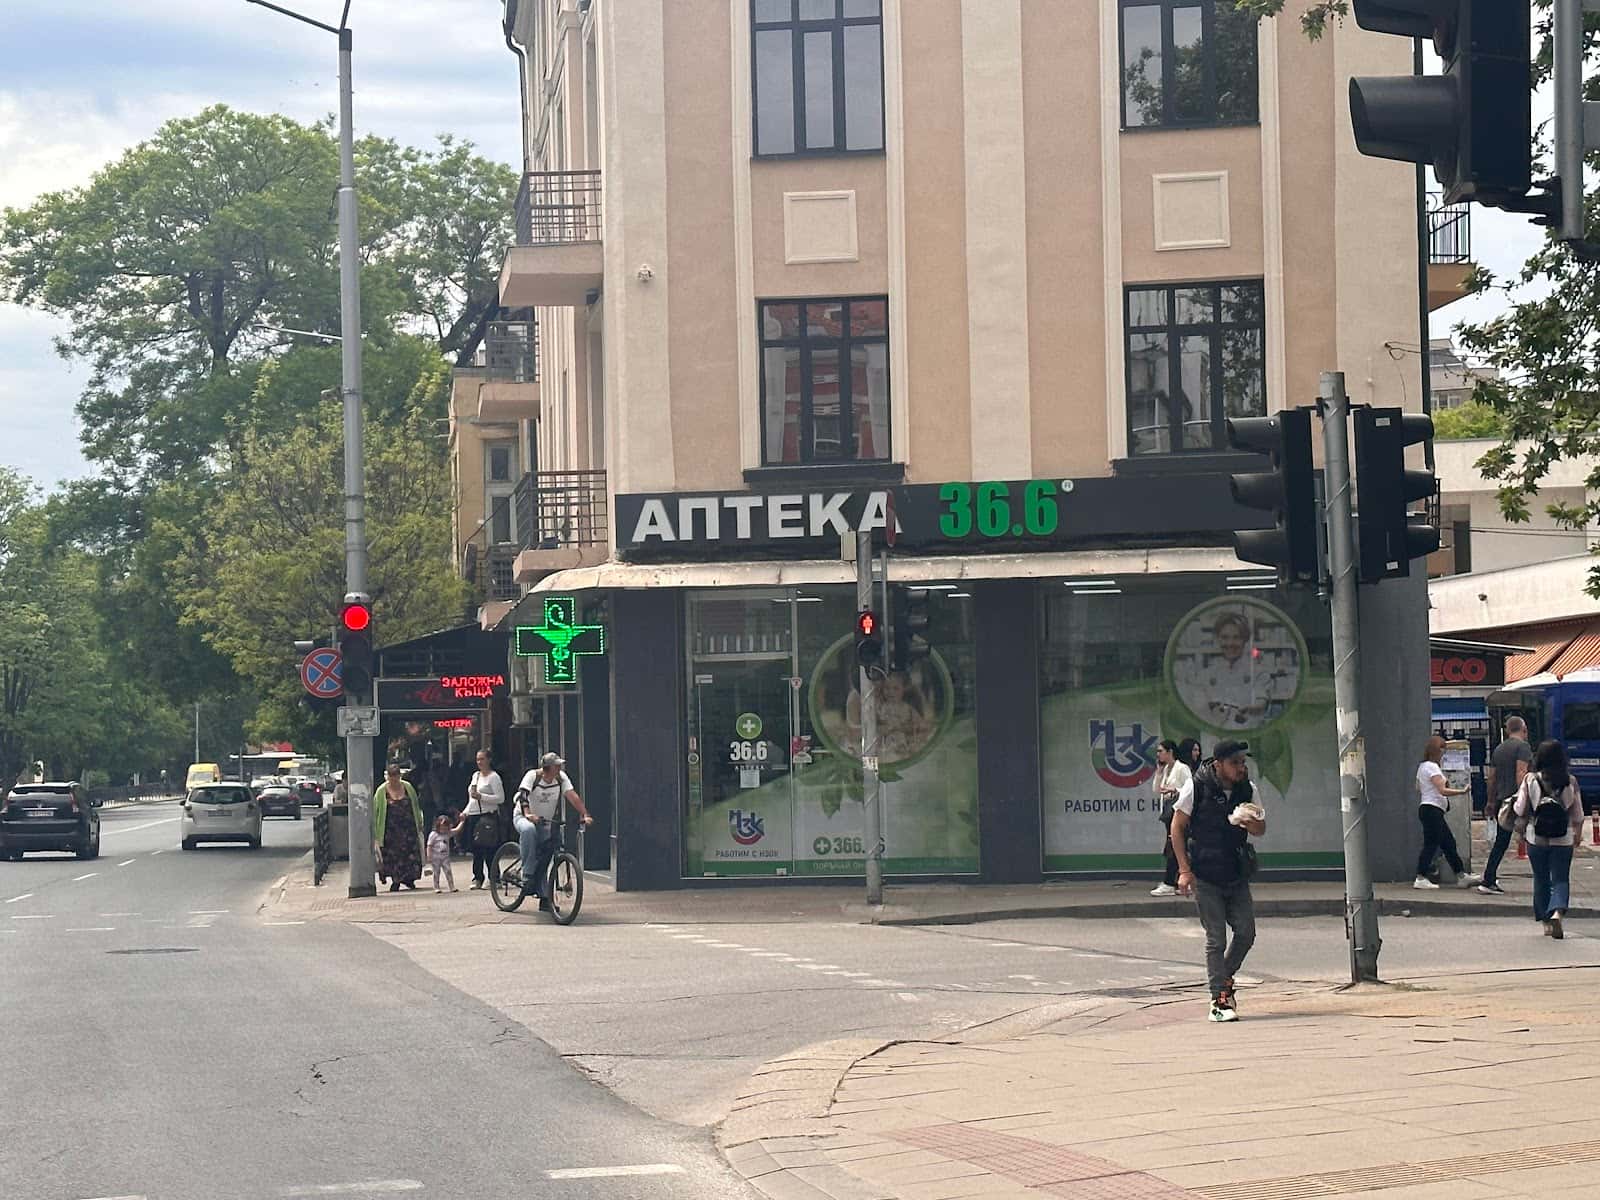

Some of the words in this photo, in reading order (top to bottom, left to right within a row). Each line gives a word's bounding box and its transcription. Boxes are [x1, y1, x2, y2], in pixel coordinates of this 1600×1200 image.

[632, 491, 903, 542] АПТЕКА
[939, 480, 1058, 537] 36.6
[442, 675, 504, 687] ЗАЛОЖНА
[455, 687, 493, 698] КЪЩА
[730, 741, 767, 760] 36.6
[1065, 800, 1130, 813] РАБОТИМ
[1137, 799, 1145, 811] С
